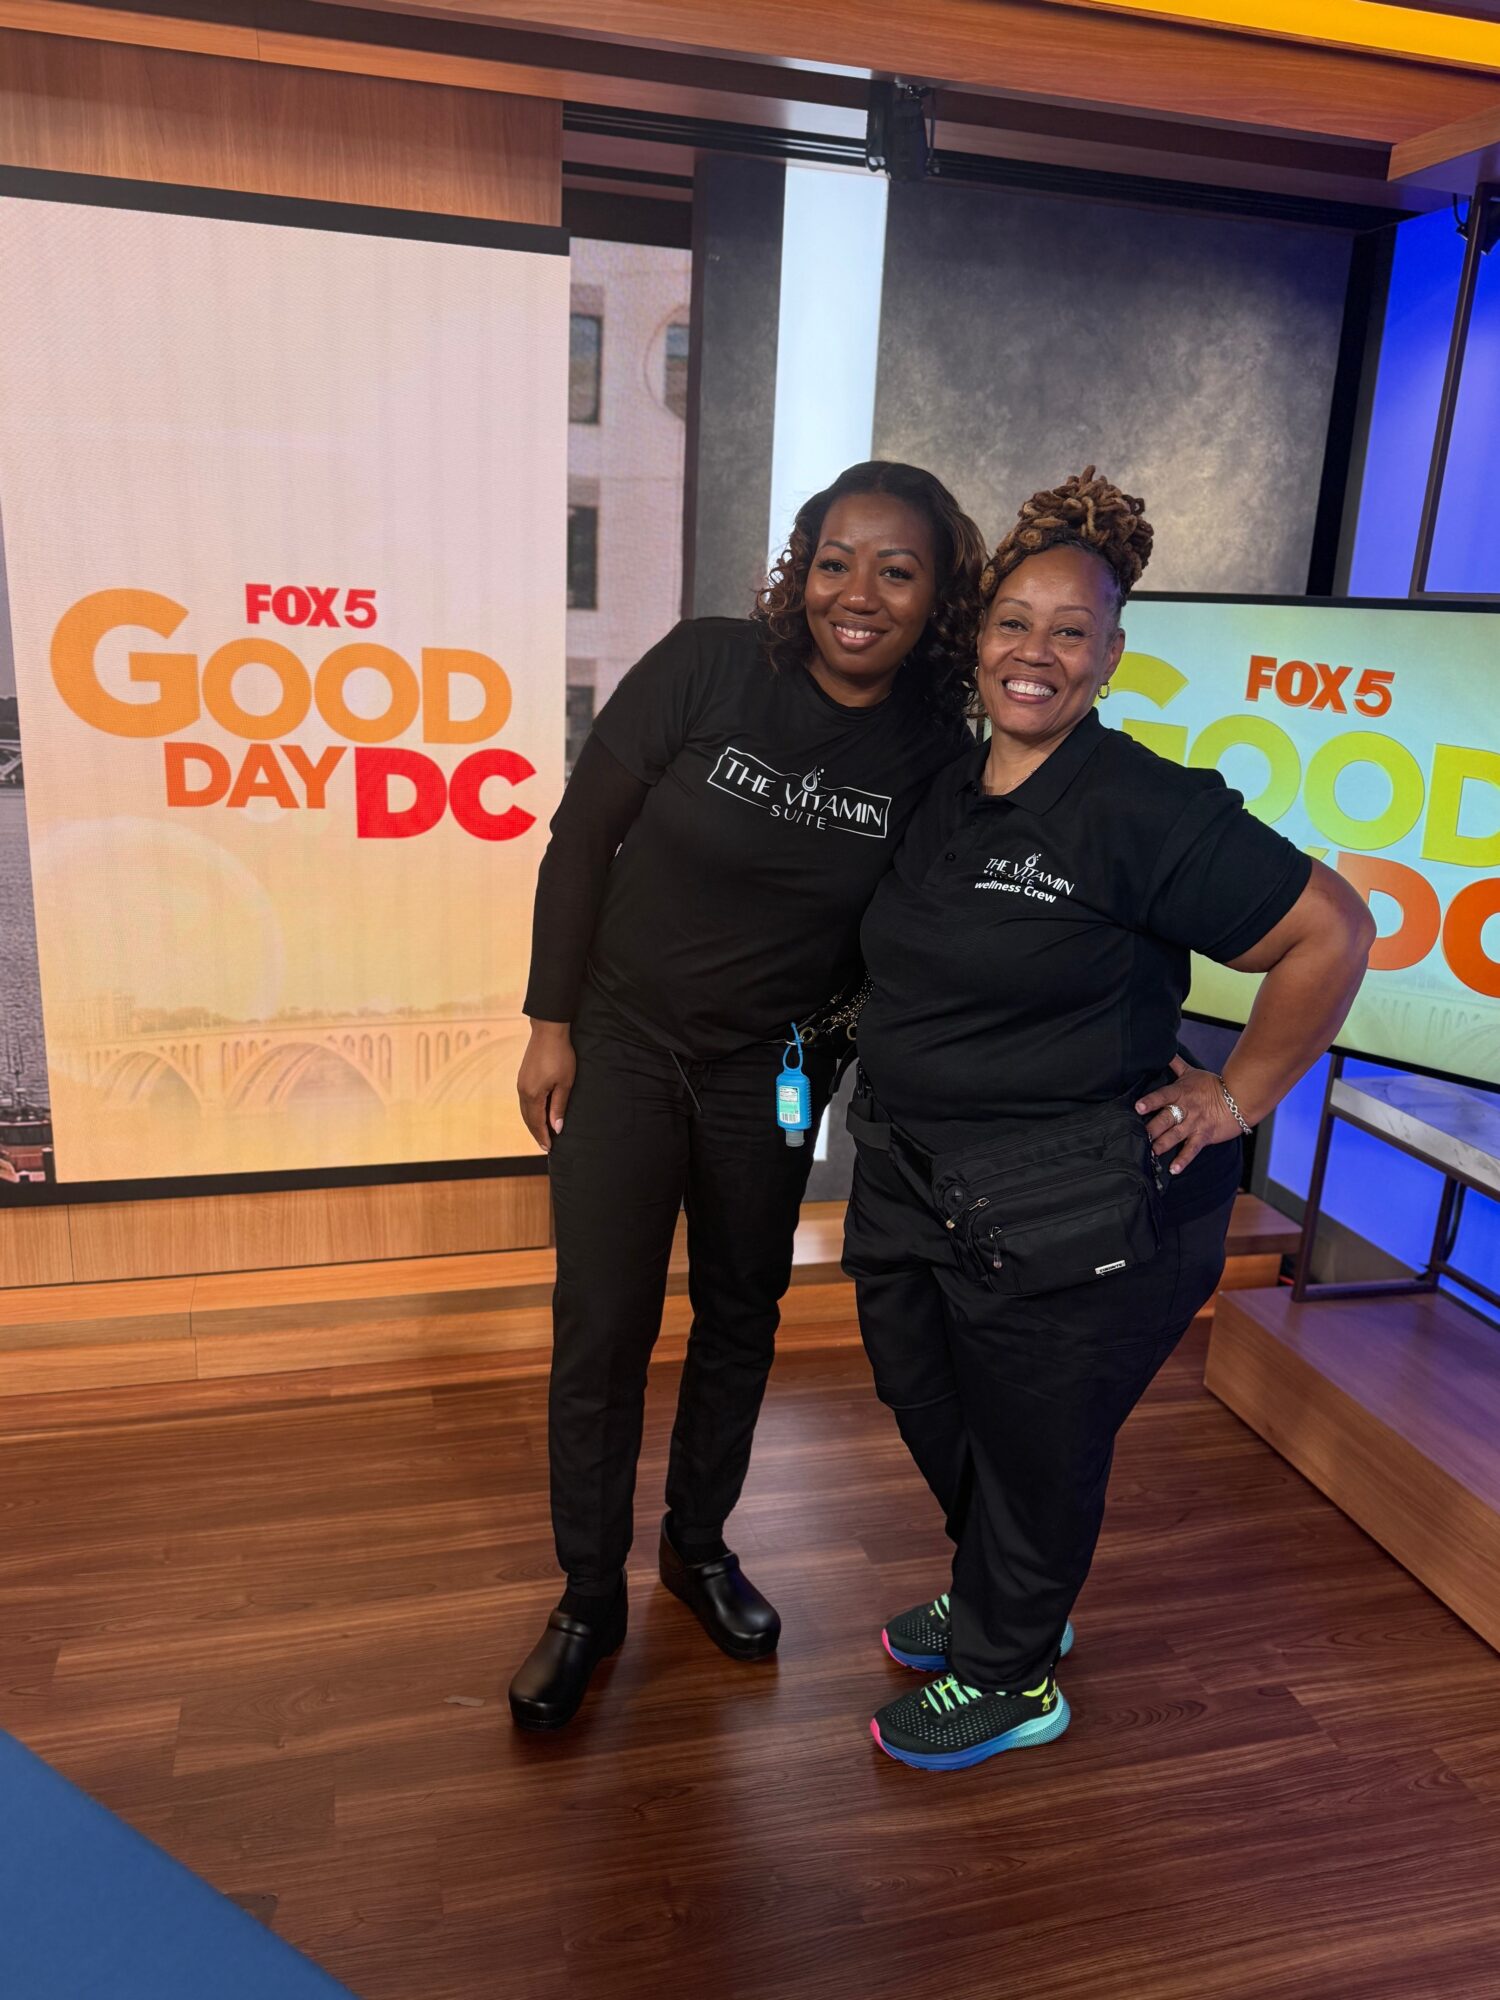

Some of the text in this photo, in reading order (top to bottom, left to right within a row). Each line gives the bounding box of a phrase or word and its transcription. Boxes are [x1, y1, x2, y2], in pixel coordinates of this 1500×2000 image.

[246, 584, 377, 628] FOX 5
[50, 588, 512, 744] GOOD
[1245, 655, 1395, 717] FOX 5
[164, 742, 537, 841] DAY DC
[725, 757, 884, 827] THE VITAMIN
[769, 804, 827, 830] SUITE
[974, 880, 1056, 903] wellness Crew
[985, 858, 1075, 895] THE VITAMIN
